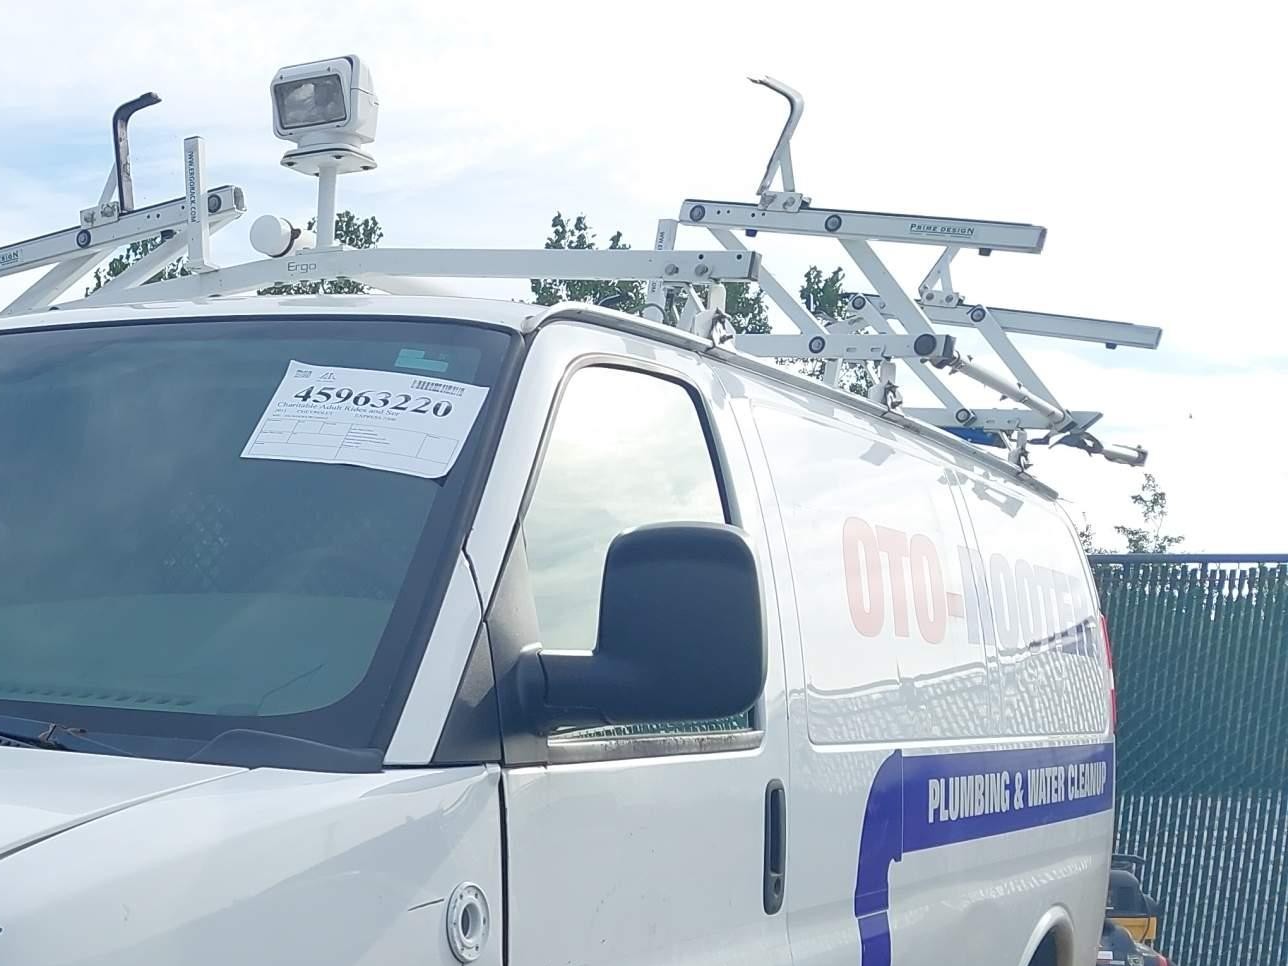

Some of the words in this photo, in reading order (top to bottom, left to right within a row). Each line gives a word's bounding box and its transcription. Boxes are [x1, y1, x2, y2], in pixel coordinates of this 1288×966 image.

[910, 223, 938, 232] PRIME
[940, 226, 975, 236] DESIGN
[287, 261, 317, 273] Ergo
[294, 385, 453, 418] 45963220
[928, 770, 1010, 824] PLUMBING
[1013, 772, 1024, 810] &
[1027, 766, 1065, 807] WATER
[1067, 761, 1107, 801] CLEANUP
